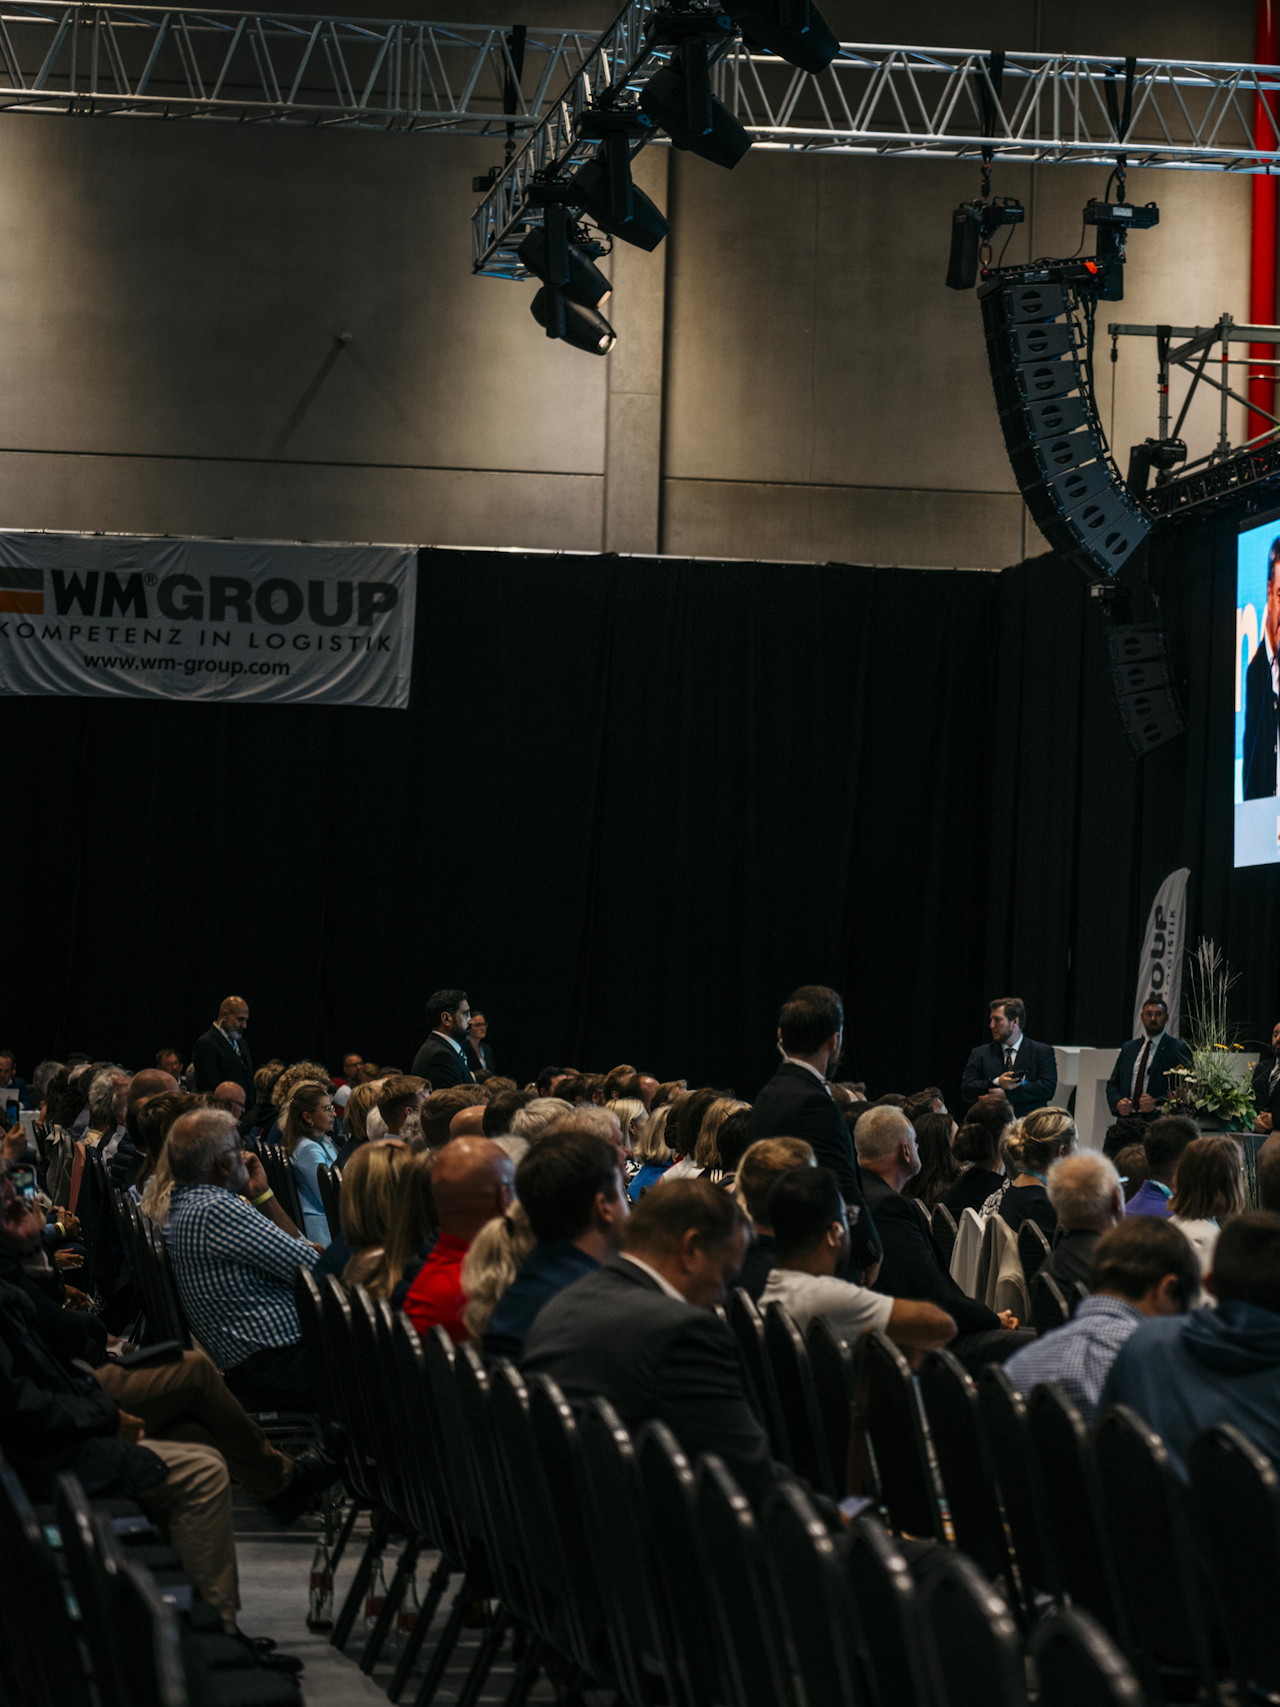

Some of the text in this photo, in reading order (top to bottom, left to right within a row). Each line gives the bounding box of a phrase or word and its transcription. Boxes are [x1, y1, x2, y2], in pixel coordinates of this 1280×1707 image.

[201, 631, 230, 647] IN
[249, 633, 391, 652] LOGISTIK
[84, 655, 290, 677] www.wm-group.com
